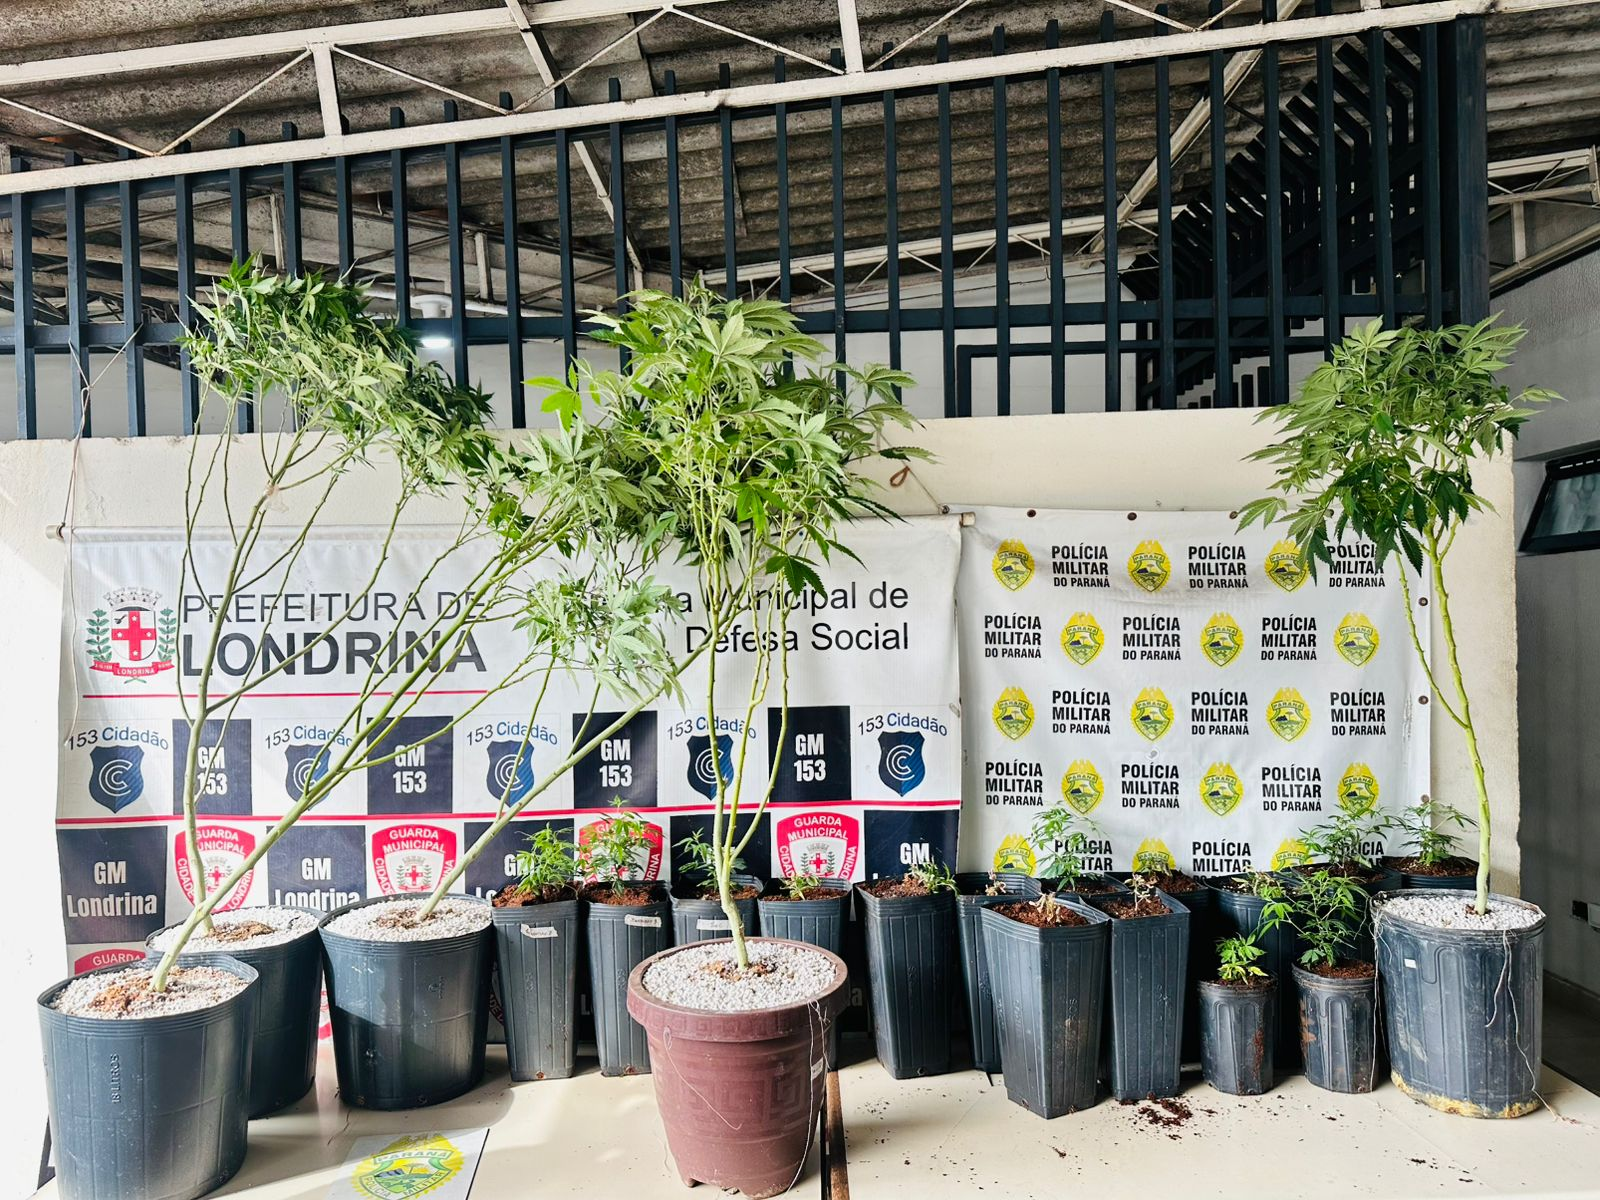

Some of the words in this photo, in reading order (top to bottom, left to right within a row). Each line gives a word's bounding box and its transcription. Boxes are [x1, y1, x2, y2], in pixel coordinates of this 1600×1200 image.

[1052, 543, 1108, 559] POLÍCIA
[1188, 543, 1246, 560] POLÍCIA
[1327, 541, 1375, 559] POLÍCI
[1052, 561, 1109, 575] MILITAR
[1188, 562, 1247, 576] MILITAR
[1053, 577, 1067, 587] DO
[1071, 576, 1110, 588] PARANÁ
[1189, 578, 1204, 588] DO
[1207, 576, 1249, 588] PARANÁ
[1329, 577, 1342, 588] DO
[1345, 575, 1386, 588] PARANÁ
[869, 581, 909, 609] de
[184, 592, 426, 623] PREFEITURA
[438, 591, 487, 620] DE
[985, 613, 1042, 630] POLÍCIA
[1123, 614, 1181, 631] POLÍCIA
[1262, 614, 1317, 631] POLÍCIA
[686, 624, 799, 653] Defesa
[811, 622, 909, 651] Social
[985, 632, 1041, 646] MILITAR
[1123, 634, 1181, 647] MILITAR
[1261, 634, 1317, 648] MILITAR
[183, 630, 487, 677] LONDRINA
[985, 648, 998, 658] DO
[1002, 647, 1042, 659] PARANÁ
[1122, 650, 1137, 660] DO
[1140, 648, 1181, 661] PARANÁ
[1261, 650, 1275, 660] DO
[1277, 648, 1317, 661] PARANÁ
[1052, 688, 1111, 706] POLÍCIA
[1191, 689, 1249, 706] POLÍCIA
[1330, 689, 1386, 706] POLÍCIA
[1052, 707, 1111, 721] MILITAR
[1191, 708, 1248, 722] MILITAR
[1330, 708, 1386, 722] MILITAR
[667, 719, 693, 740] 153
[696, 716, 757, 739] Cdadão
[858, 715, 884, 736] 153
[887, 712, 948, 737] Cidadão
[1053, 723, 1067, 733] DO
[1070, 722, 1111, 734] PARANÁ
[1191, 725, 1206, 735] DO
[1208, 723, 1249, 735] PARANÁ
[1332, 725, 1346, 736] DO
[1350, 724, 1386, 736] PARANÁ
[69, 729, 98, 750] 153
[102, 726, 169, 750] Cidadão
[265, 728, 290, 749] 153
[467, 724, 494, 746] 153
[496, 721, 558, 745] Cidadão
[600, 739, 631, 762] GM
[795, 733, 825, 756] GM
[197, 746, 226, 769] GM
[394, 744, 425, 767] GM
[599, 765, 633, 788] 153
[793, 759, 827, 782] 153
[985, 759, 1043, 777] POLÍCIA
[1121, 762, 1179, 779] POLÍCIA
[1261, 764, 1322, 782] POLÍCIA
[197, 772, 228, 795] 153
[392, 771, 427, 794] 153
[985, 778, 1043, 793] MILITAR
[1121, 781, 1180, 795] MILITAR
[1262, 783, 1322, 798] MILITAR
[986, 795, 999, 805] DO
[1003, 794, 1043, 806] PARANÁ
[1121, 797, 1136, 808] DO
[1139, 797, 1180, 808] PARANÁ
[1263, 801, 1277, 811] DO
[1281, 799, 1322, 811] PARANÁ
[793, 815, 842, 827] GUARDA
[389, 828, 439, 840] GUARDA
[787, 827, 849, 841] MUNICIPAL
[198, 841, 246, 855] UNICIPAL
[382, 839, 447, 854] MUNICIPAL
[900, 842, 930, 865] GM
[1192, 838, 1251, 857] POLÍCIA
[302, 857, 331, 881] GM
[779, 845, 796, 878] CIDAD
[841, 845, 857, 880] DRINA
[1193, 858, 1251, 873] MILITAR
[94, 861, 127, 885] GM
[227, 869, 253, 909] LONDRI
[66, 892, 158, 918] Londrina
